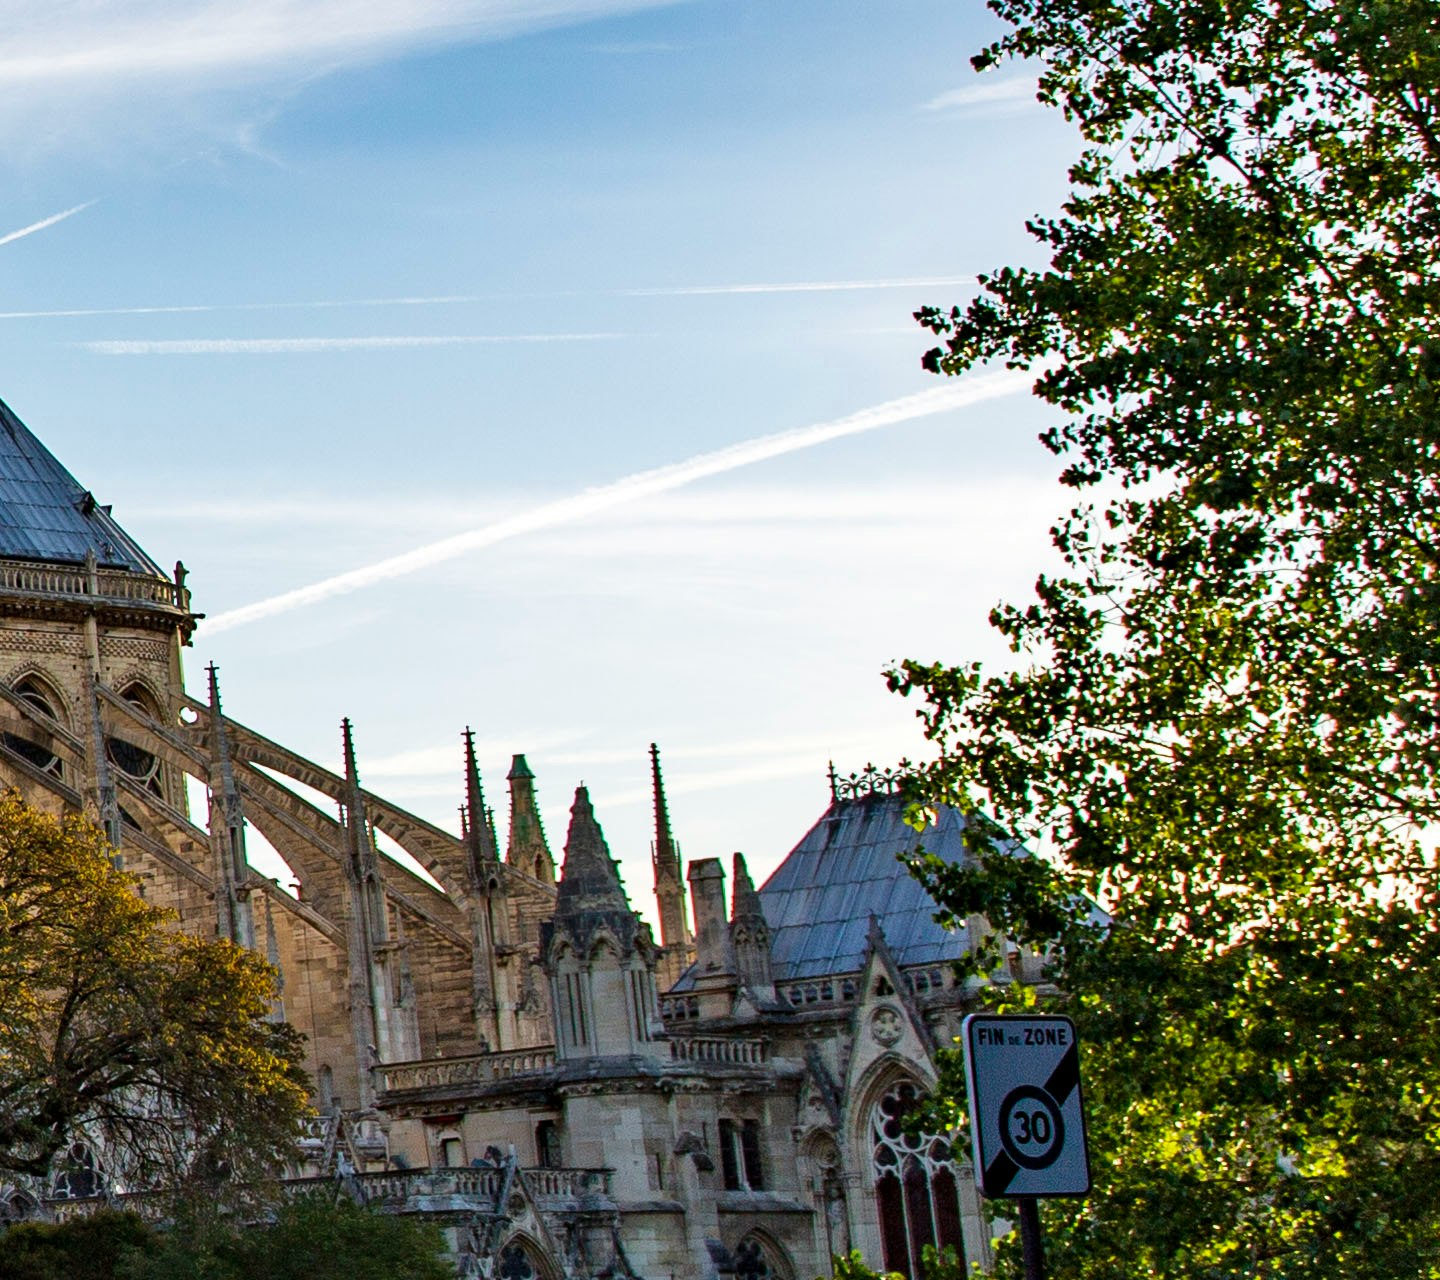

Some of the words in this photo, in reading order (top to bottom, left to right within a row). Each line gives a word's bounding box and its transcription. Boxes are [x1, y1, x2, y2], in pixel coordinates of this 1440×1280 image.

[978, 1028, 1004, 1046] FIN
[1008, 1035, 1021, 1046] DE
[1024, 1028, 1068, 1046] ZONE
[1013, 1111, 1051, 1145] 30
